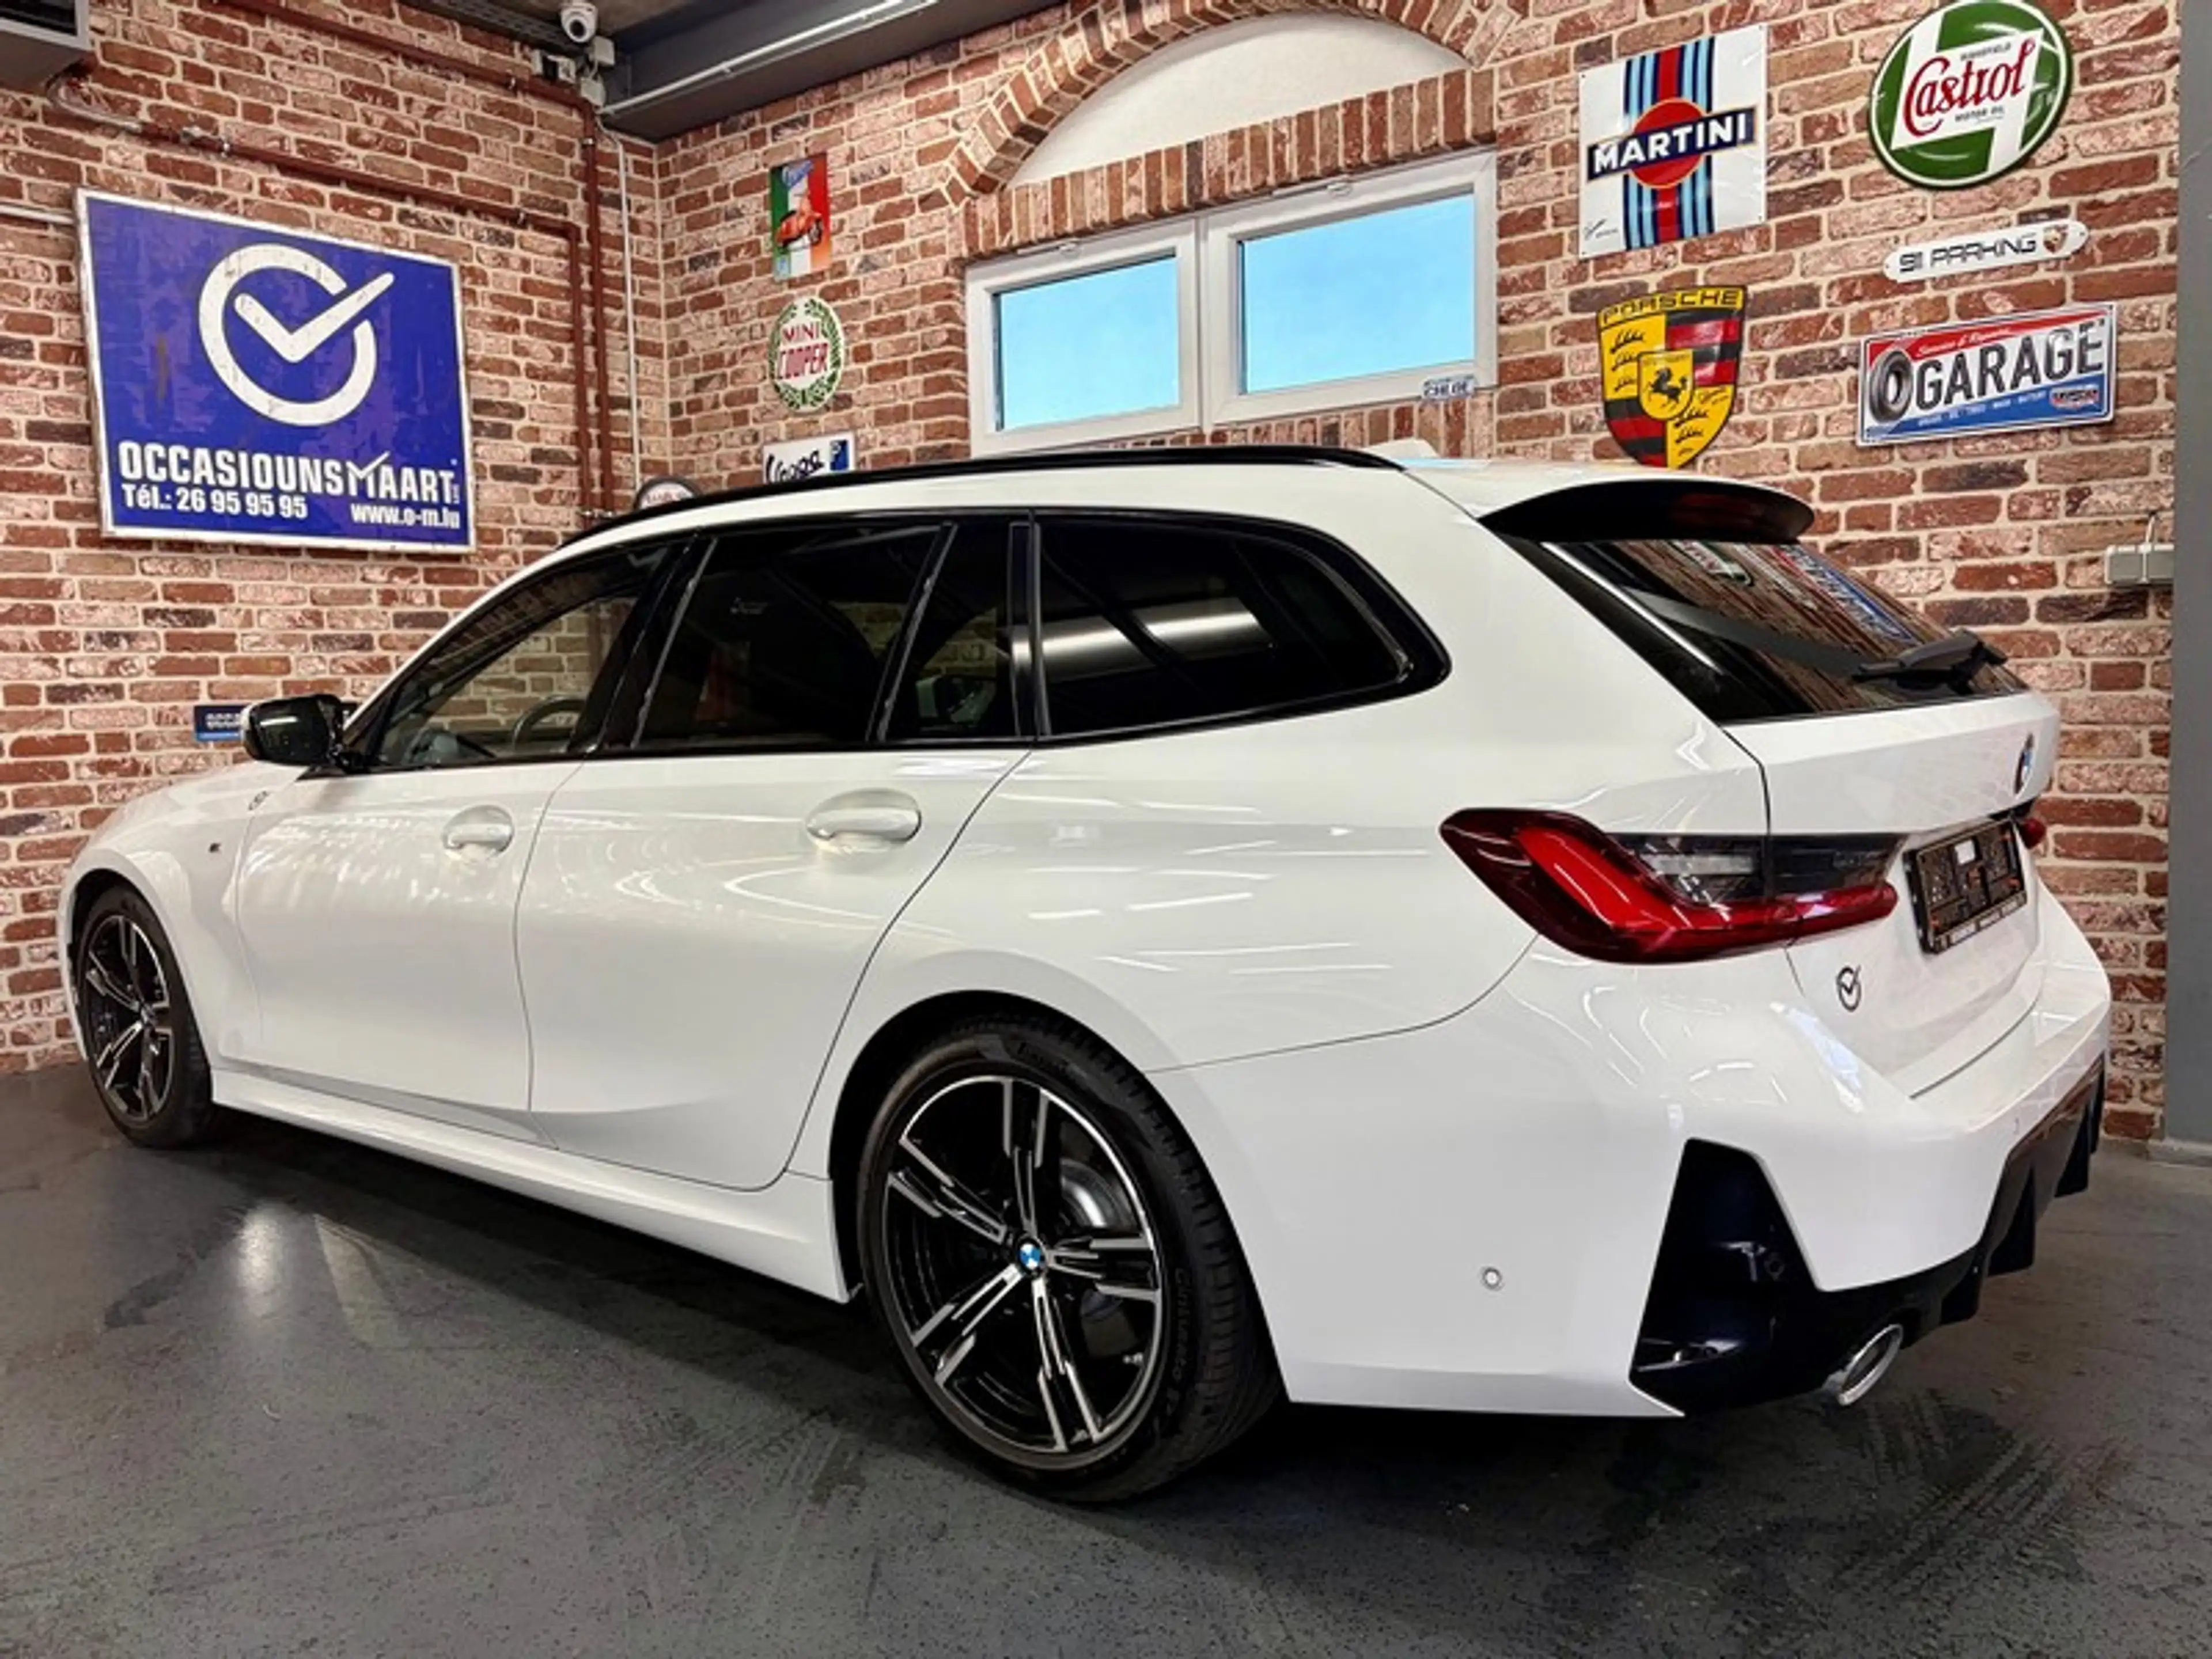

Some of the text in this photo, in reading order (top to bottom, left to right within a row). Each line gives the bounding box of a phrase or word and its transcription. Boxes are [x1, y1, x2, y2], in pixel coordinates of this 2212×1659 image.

[1904, 37, 2036, 138] Castrol
[1593, 112, 1747, 174] MARTINI
[1899, 233, 2037, 273] 911 PARKING
[1603, 290, 1739, 324] PORSCHE
[781, 320, 820, 344] MINI
[778, 343, 828, 380] COOPER
[1916, 319, 2105, 410] GARAGE
[176, 487, 206, 513] 26
[210, 489, 241, 516] 95
[245, 491, 275, 517] 95
[279, 494, 308, 519] 95
[350, 502, 460, 529] www.o-m.lu
